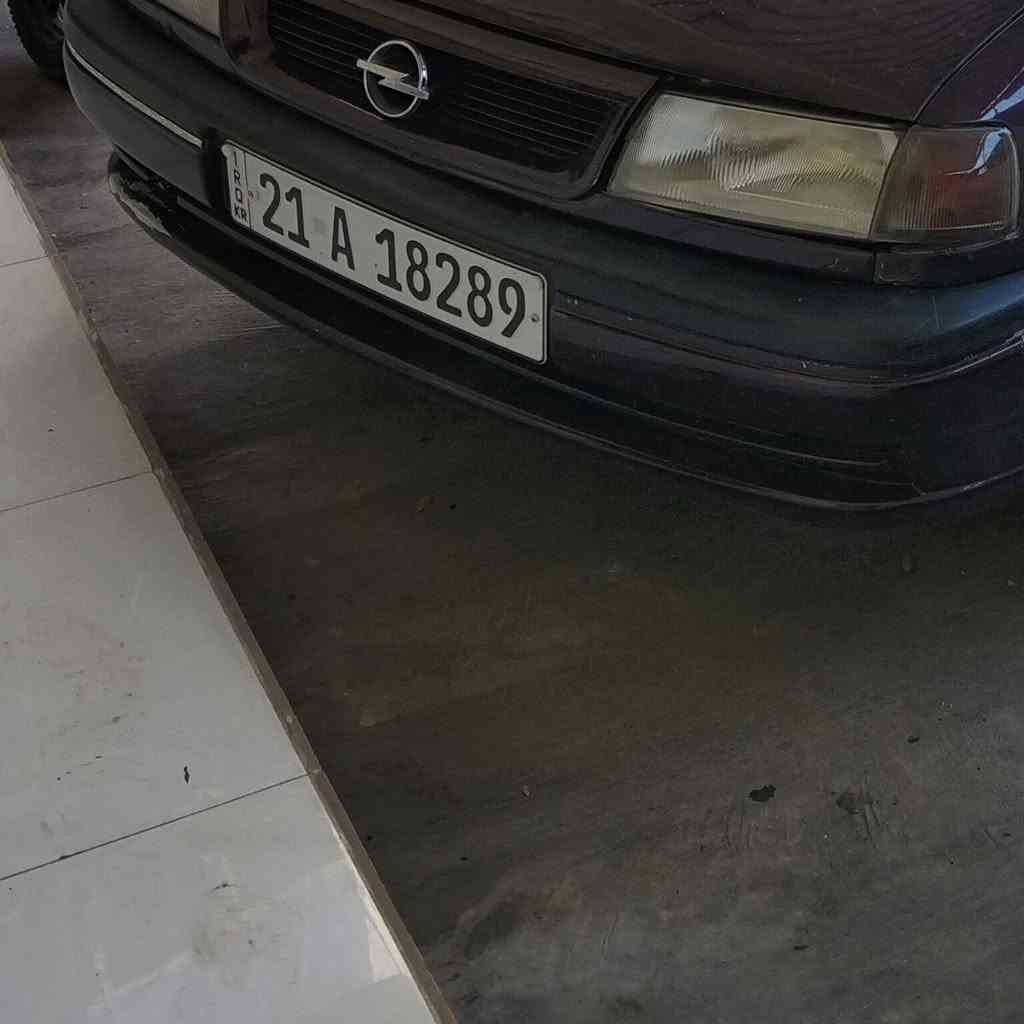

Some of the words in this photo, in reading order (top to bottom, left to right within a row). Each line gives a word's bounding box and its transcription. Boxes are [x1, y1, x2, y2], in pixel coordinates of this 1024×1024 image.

[259, 173, 310, 248] 21
[330, 206, 355, 270] A
[375, 228, 527, 338] 18289
